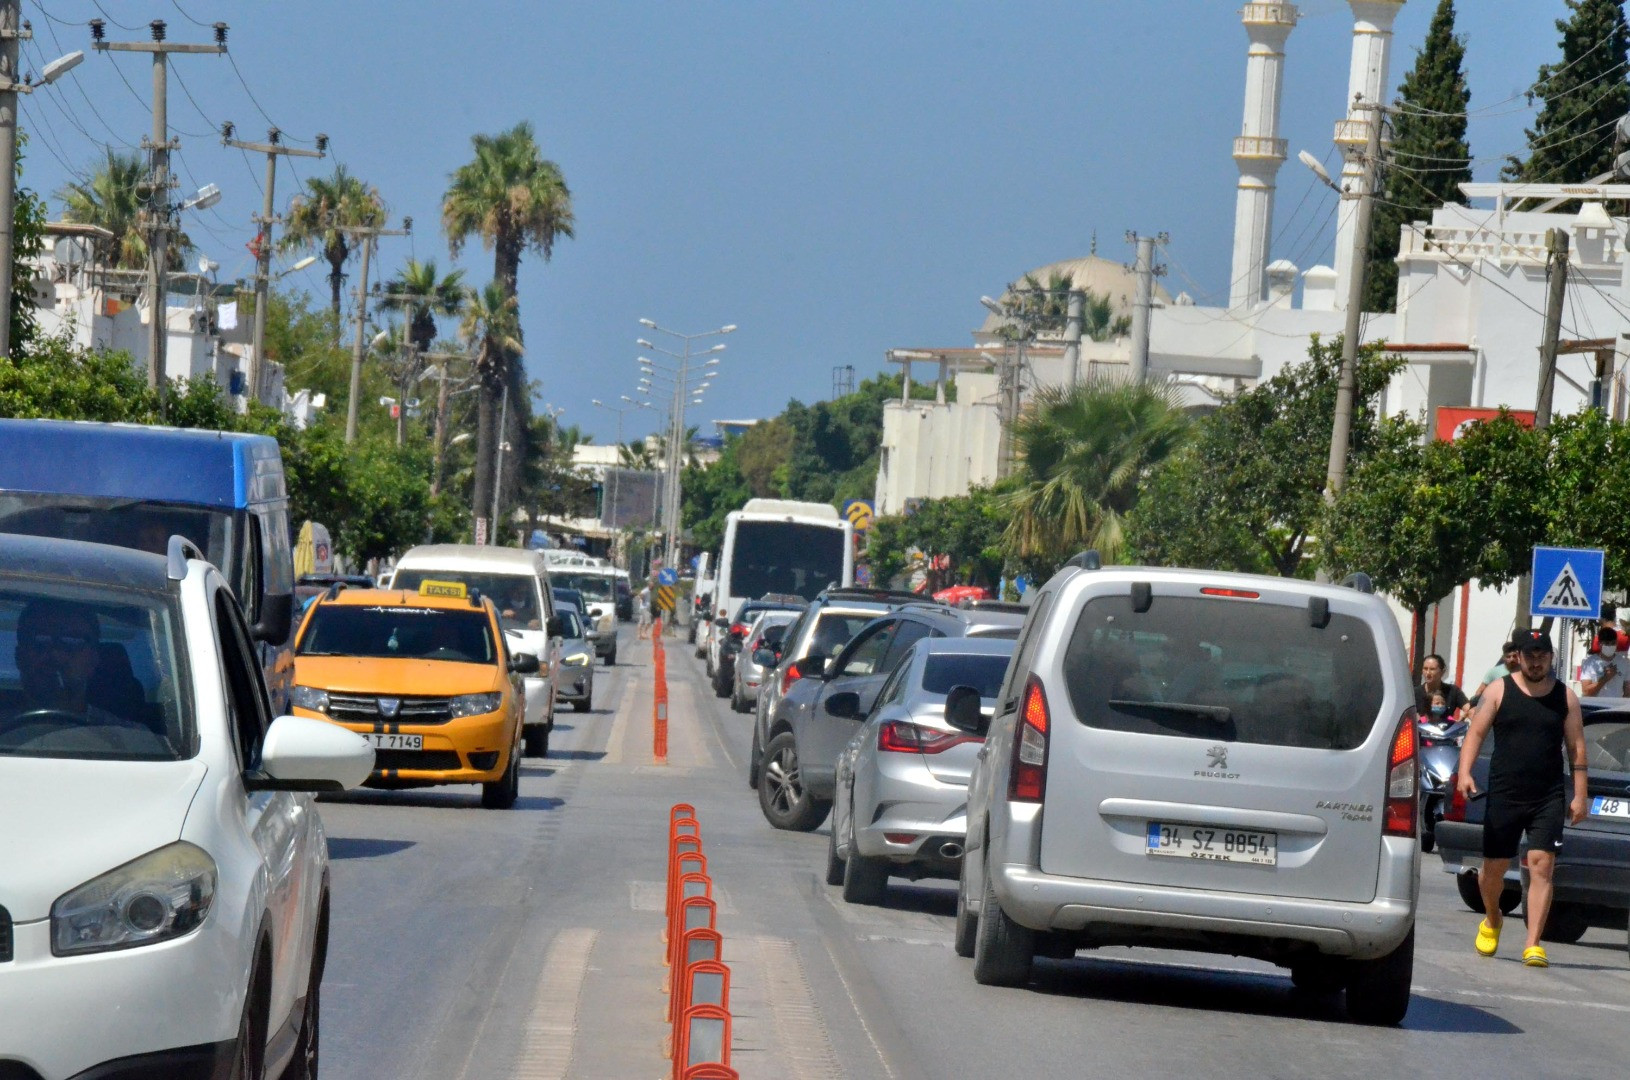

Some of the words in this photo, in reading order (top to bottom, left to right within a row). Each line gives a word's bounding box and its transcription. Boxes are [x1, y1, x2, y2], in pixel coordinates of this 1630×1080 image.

[375, 735, 383, 747] T
[389, 736, 421, 748] 7149
[1316, 801, 1373, 812] PARTNER
[1601, 799, 1620, 813] 48
[1160, 827, 1182, 848] 34
[1192, 829, 1215, 851] SZ
[1224, 833, 1269, 856] 8854
[1191, 852, 1231, 860] ÖZTEK
